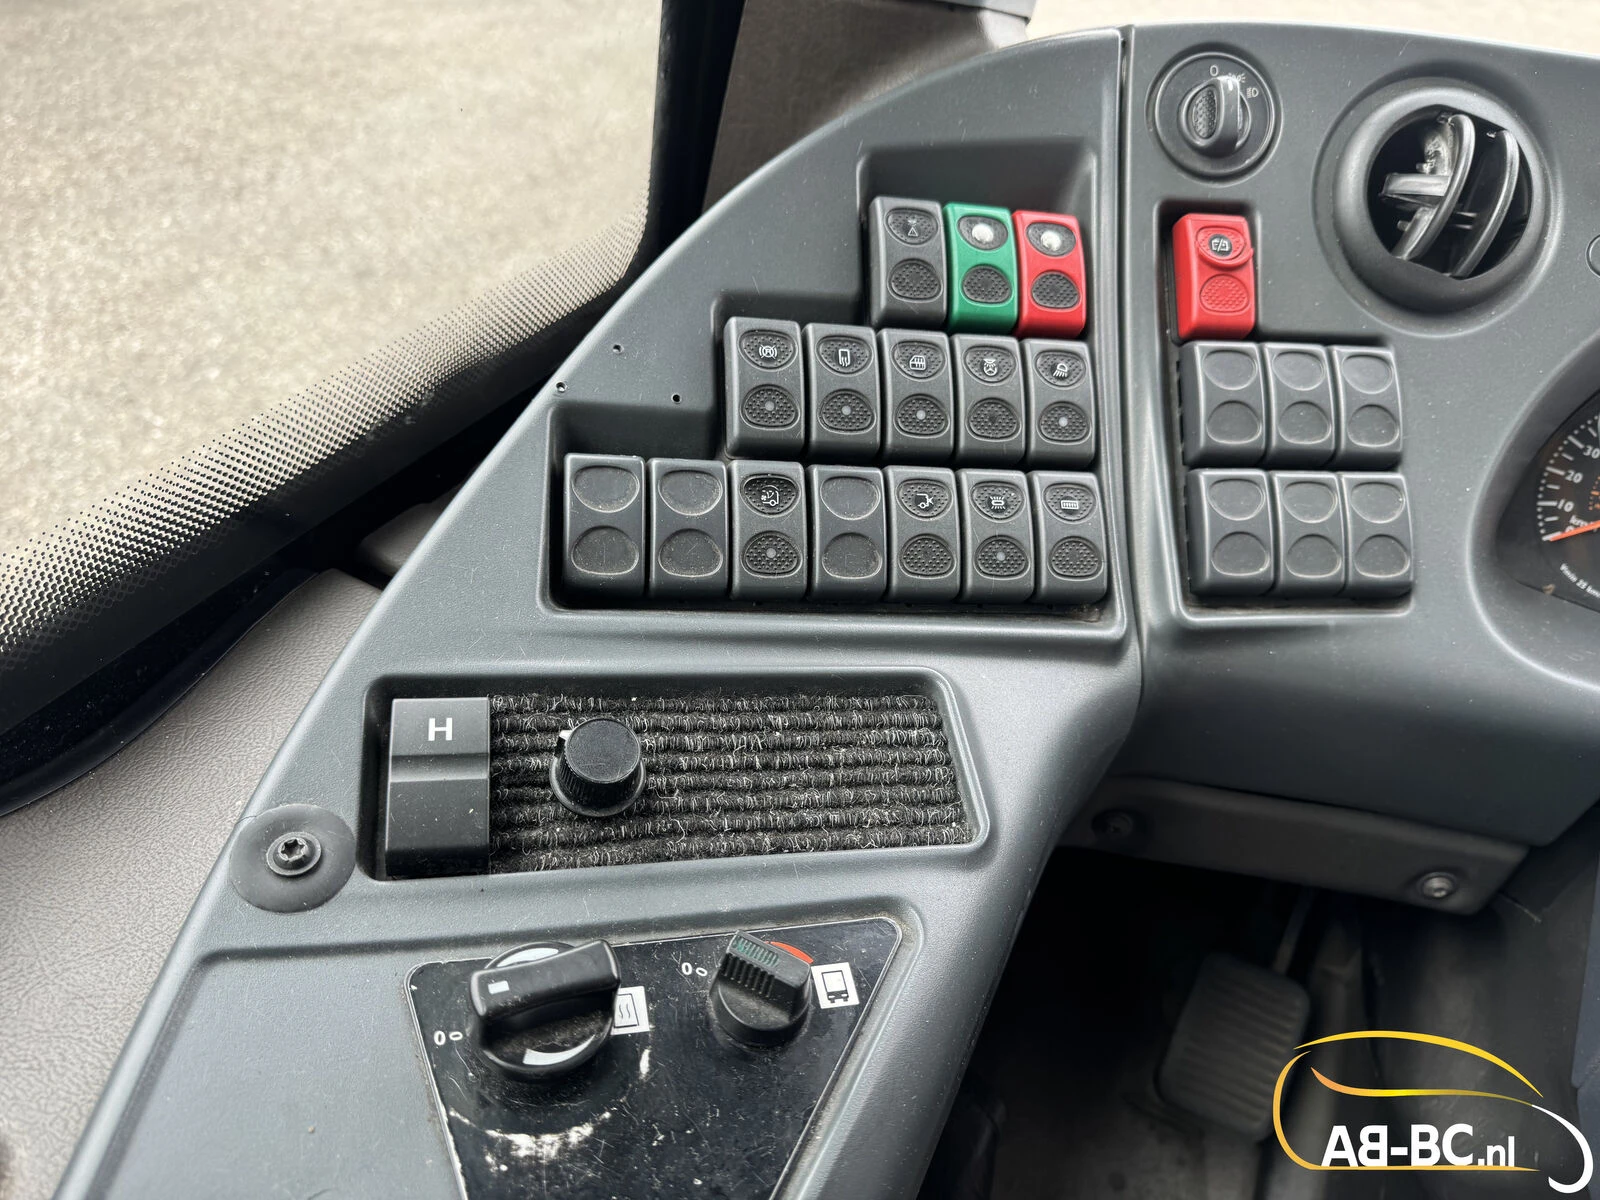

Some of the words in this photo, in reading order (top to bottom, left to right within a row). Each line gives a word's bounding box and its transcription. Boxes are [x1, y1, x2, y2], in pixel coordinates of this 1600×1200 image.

[1565, 470, 1583, 484] 20
[1557, 499, 1574, 513] 10
[427, 717, 453, 741] H
